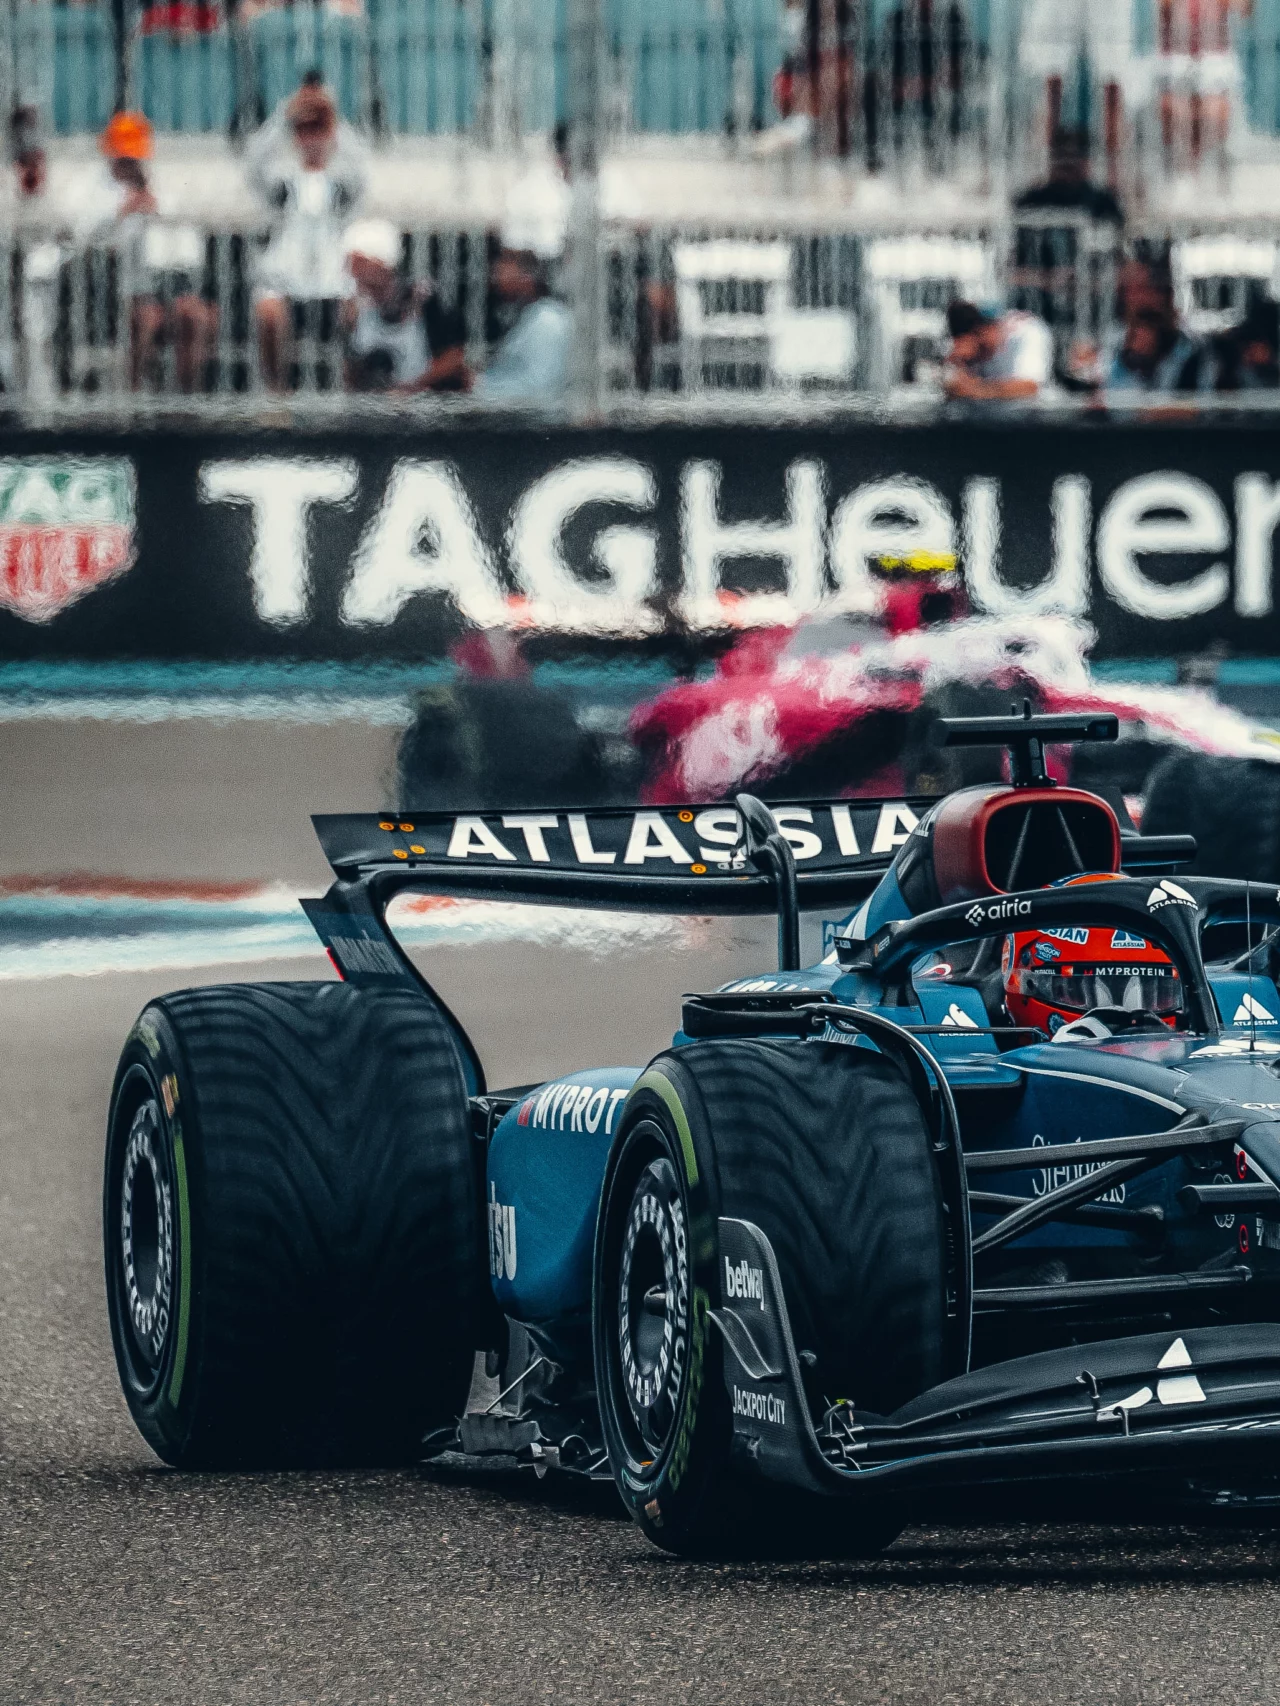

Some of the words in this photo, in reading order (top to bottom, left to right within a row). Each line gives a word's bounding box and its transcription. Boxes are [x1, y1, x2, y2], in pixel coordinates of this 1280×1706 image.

[0, 464, 117, 521] AG
[988, 899, 1032, 920] airia
[1149, 899, 1199, 913] ATLASSIAN
[1095, 967, 1165, 976] MYPROTEIN
[724, 1256, 765, 1311] betway
[732, 1385, 767, 1420] JACKPOT
[767, 1393, 786, 1425] CITY
